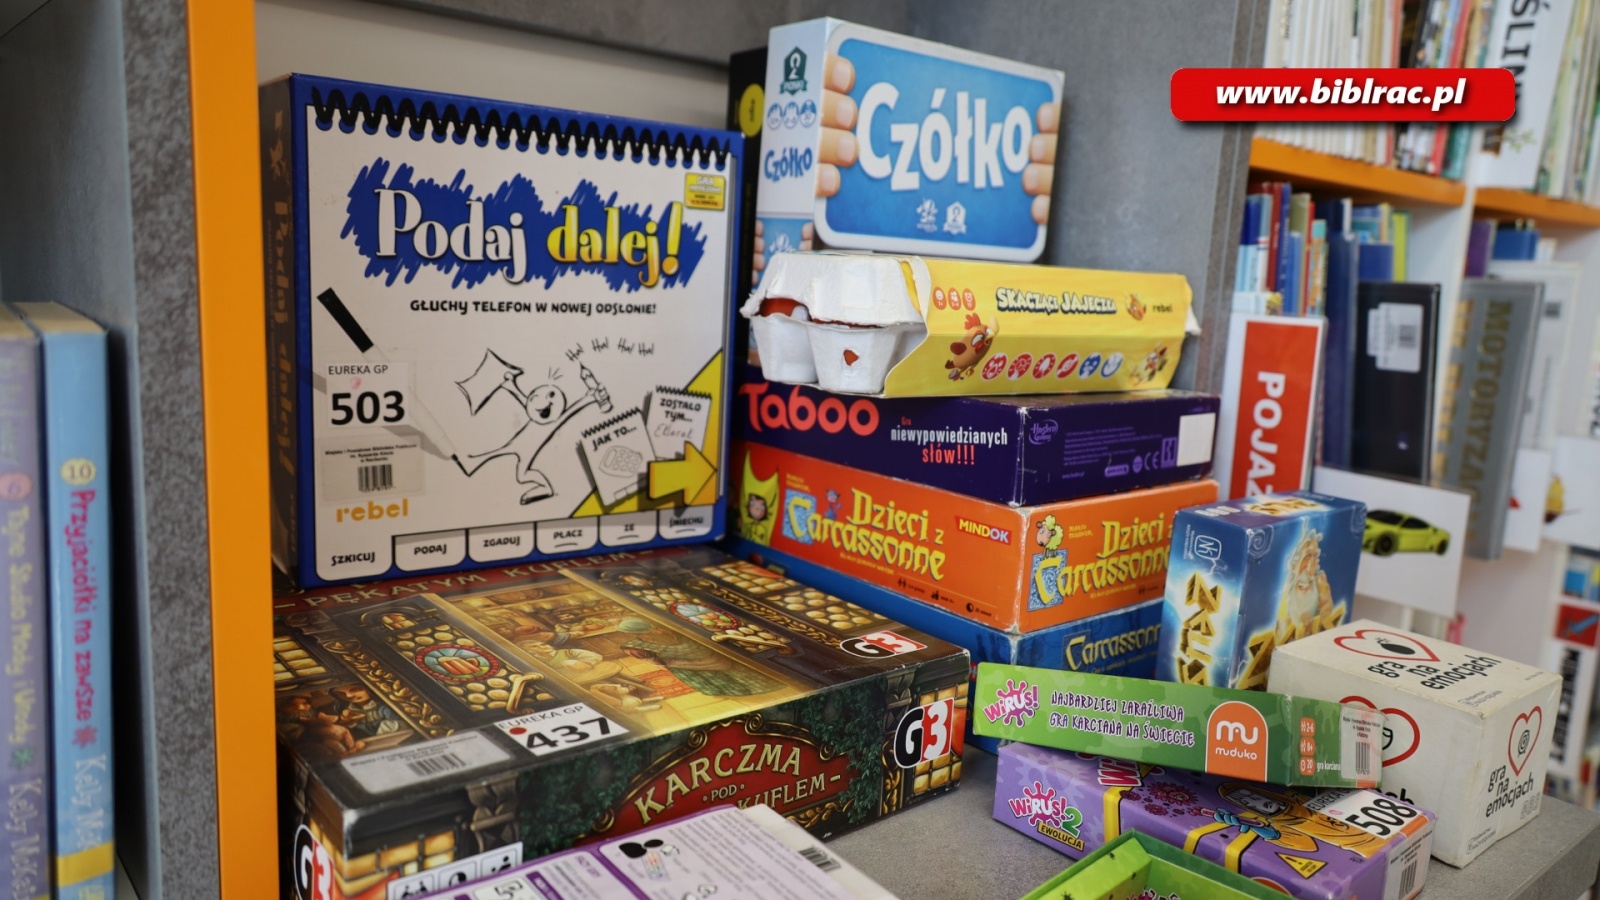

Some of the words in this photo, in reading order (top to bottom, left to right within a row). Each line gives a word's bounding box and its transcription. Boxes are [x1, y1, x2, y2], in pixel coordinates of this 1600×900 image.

[857, 81, 1033, 191] Czółko
[764, 147, 813, 183] Czółko
[374, 188, 528, 285] Podaj
[547, 201, 684, 288] dalej!
[410, 300, 468, 314] GŁUCHY
[472, 301, 532, 314] TELEFON
[536, 302, 547, 313] W
[551, 303, 592, 315] NOWEJ
[596, 303, 657, 315] ODSŁONIE!
[1061, 291, 1117, 314] JAJECZKA
[1152, 303, 1173, 313] rebel
[328, 365, 371, 375] EUREKA
[373, 364, 389, 374] GP
[331, 390, 405, 426] 503
[659, 398, 702, 412] ZOSTAŁO
[665, 411, 693, 423] TYM...
[738, 381, 880, 436] Taboo
[901, 416, 912, 426] Gra
[592, 433, 613, 451] JAK
[614, 425, 637, 438] TO...
[890, 425, 1008, 448] niewypowiedzianych
[922, 443, 975, 465] słów!!!
[68, 463, 92, 481] 10
[336, 499, 409, 523] rebel
[846, 487, 929, 542] Dzieci
[934, 528, 944, 545] z
[553, 528, 583, 541] PŁACZ
[624, 523, 635, 533] ZE
[788, 496, 946, 581] Carcassonne
[959, 518, 1010, 544] MINDOK
[1096, 512, 1165, 558] Dzieci
[65, 489, 98, 613] Przyjaciółki
[413, 543, 448, 556] PODAJ
[483, 535, 521, 548] ZGADUJ
[331, 551, 376, 567] SZKICUJ
[74, 620, 92, 645] na
[1367, 661, 1407, 679] gra
[1406, 664, 1441, 678] na
[1420, 654, 1503, 690] emocjach
[75, 650, 95, 722] zawsze
[498, 709, 562, 730] EUREKA
[563, 704, 584, 715] GP
[1051, 690, 1117, 713] NAJBARDZIEJ
[1121, 699, 1185, 723] ZARAŹLIWA
[525, 717, 613, 751] 437
[893, 697, 955, 769] G3
[1049, 712, 1069, 728] GRA
[1072, 716, 1123, 737] KARCIANA
[1126, 722, 1141, 739] NA
[1142, 720, 1195, 748] ŚWIECIE
[1215, 747, 1257, 760] muduko
[72, 753, 107, 808] Kelly
[634, 743, 801, 825] KARCZMA
[1488, 765, 1506, 793] gra
[1497, 777, 1509, 796] na
[5, 777, 42, 834] Kelly
[711, 785, 737, 802] POD
[1307, 789, 1342, 811] EUREKA
[1486, 772, 1534, 818] emocjach
[77, 809, 105, 851] McK
[1061, 806, 1083, 838] 2
[1345, 799, 1418, 836] 508
[1040, 825, 1083, 850] EWOLUCJA
